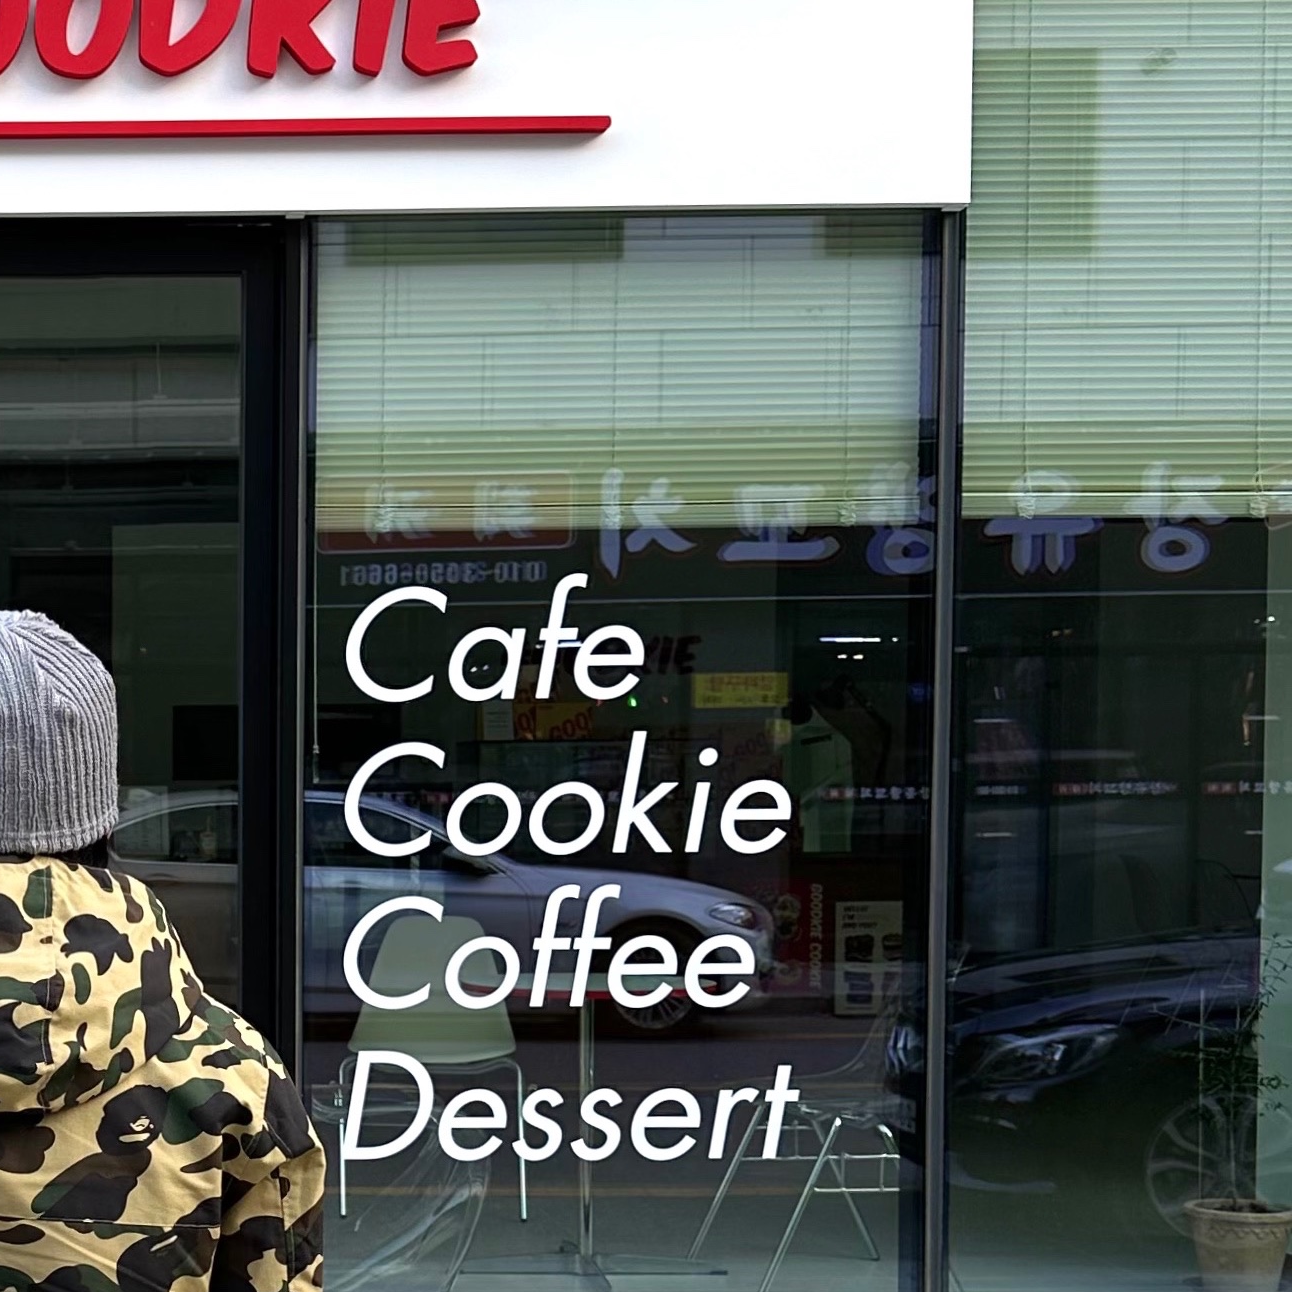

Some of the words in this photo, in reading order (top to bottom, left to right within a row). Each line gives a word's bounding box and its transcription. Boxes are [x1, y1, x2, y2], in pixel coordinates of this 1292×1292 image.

[345, 574, 645, 703] Cafe
[344, 731, 792, 857] Cookie
[343, 884, 755, 1010] Coffee
[345, 1050, 800, 1162] Dessert
